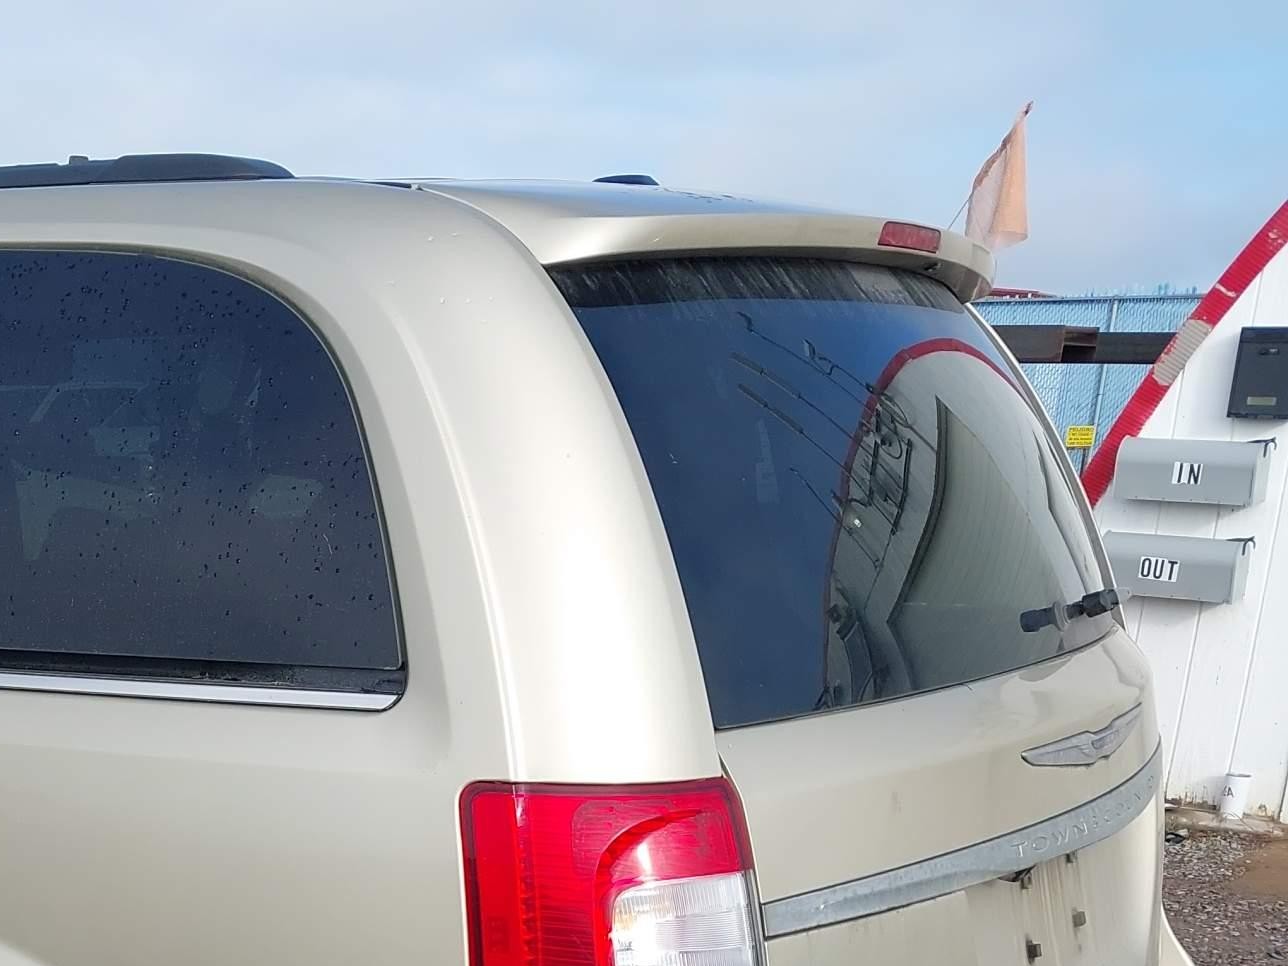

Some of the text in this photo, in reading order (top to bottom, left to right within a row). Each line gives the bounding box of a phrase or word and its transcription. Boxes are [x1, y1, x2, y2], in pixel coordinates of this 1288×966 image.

[1176, 463, 1202, 485] IN
[1140, 557, 1179, 581] OUT
[1011, 816, 1089, 858] TOWN
